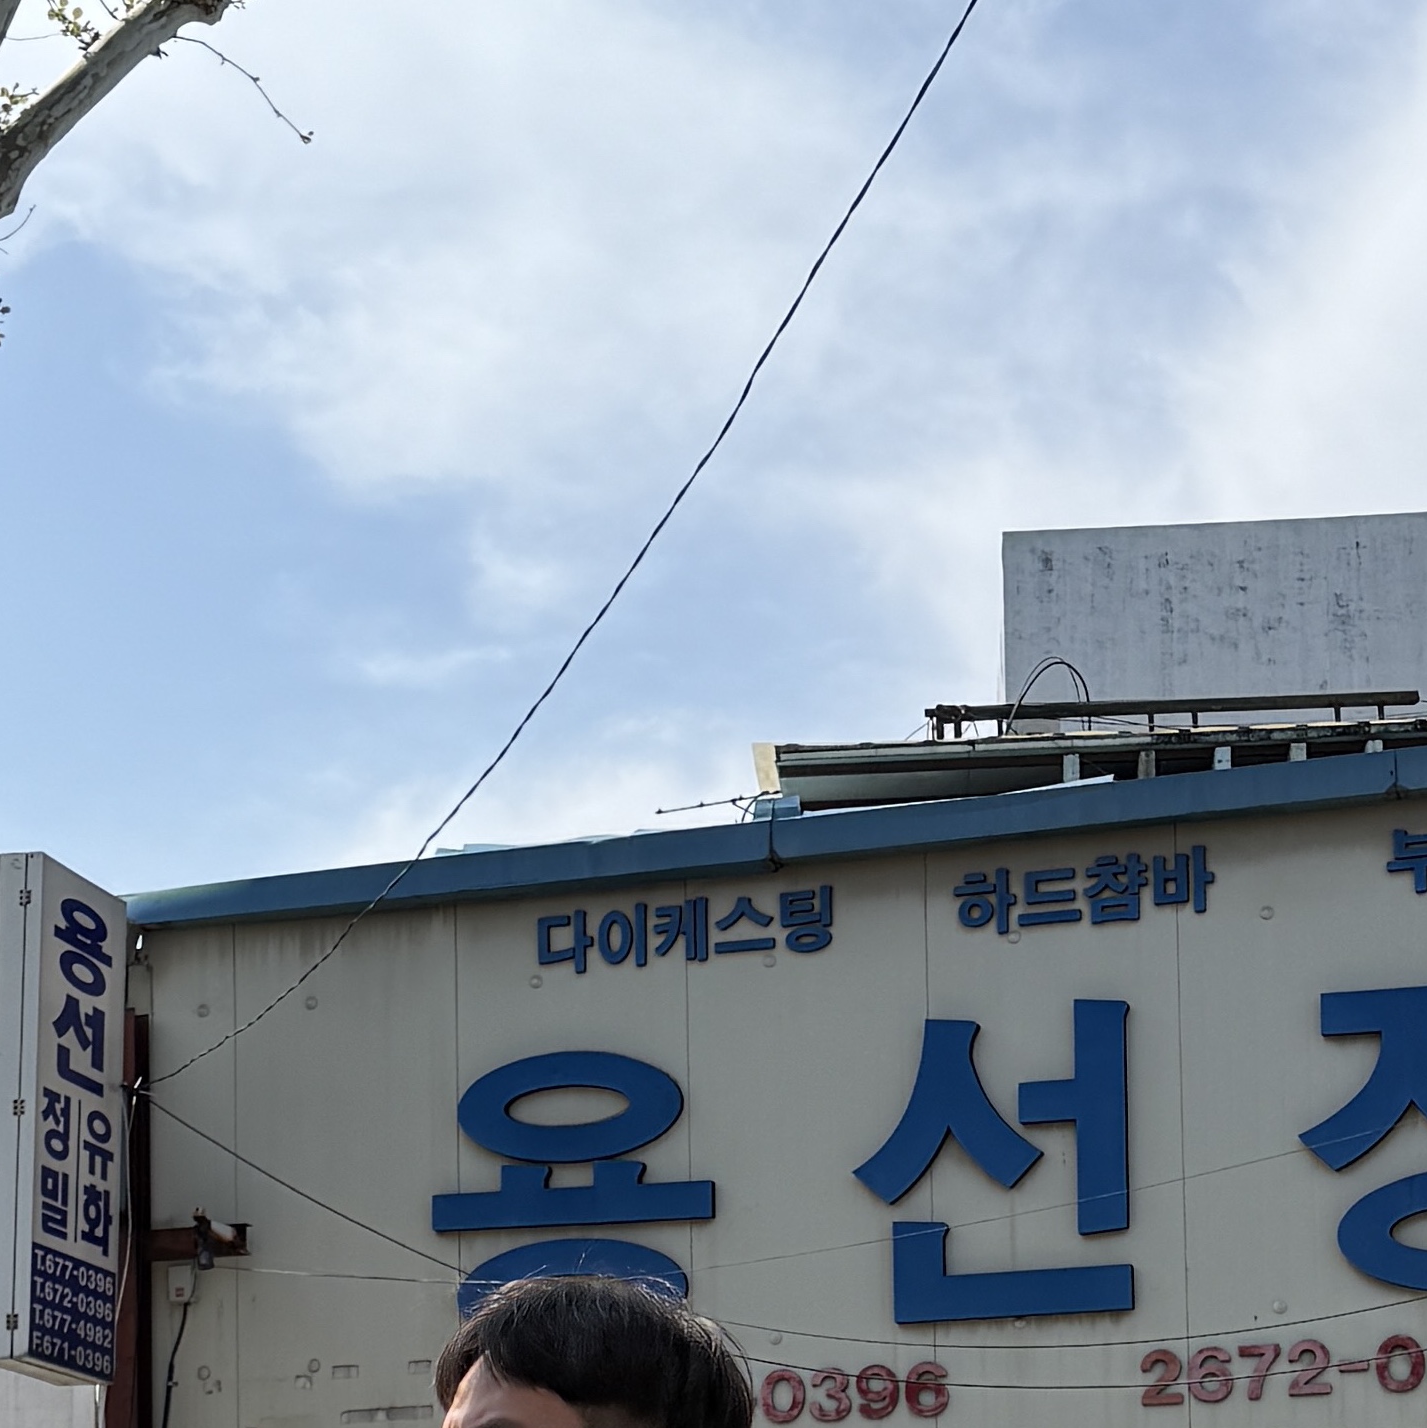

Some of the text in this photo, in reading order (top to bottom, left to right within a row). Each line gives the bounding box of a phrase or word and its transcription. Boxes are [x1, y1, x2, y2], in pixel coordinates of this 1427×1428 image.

[537, 885, 833, 974] 다이케스팅
[953, 845, 1215, 934] 하드챰바
[51, 897, 113, 1099] 용선
[40, 1086, 71, 1241] 정밀
[80, 1110, 115, 1258] 유화
[33, 1275, 113, 1322] T.672-0396
[34, 1248, 114, 1296] T.677-0396
[31, 1330, 111, 1375] F.671-0396
[32, 1303, 112, 1348] T.677-4982
[758, 1360, 951, 1425] 0396
